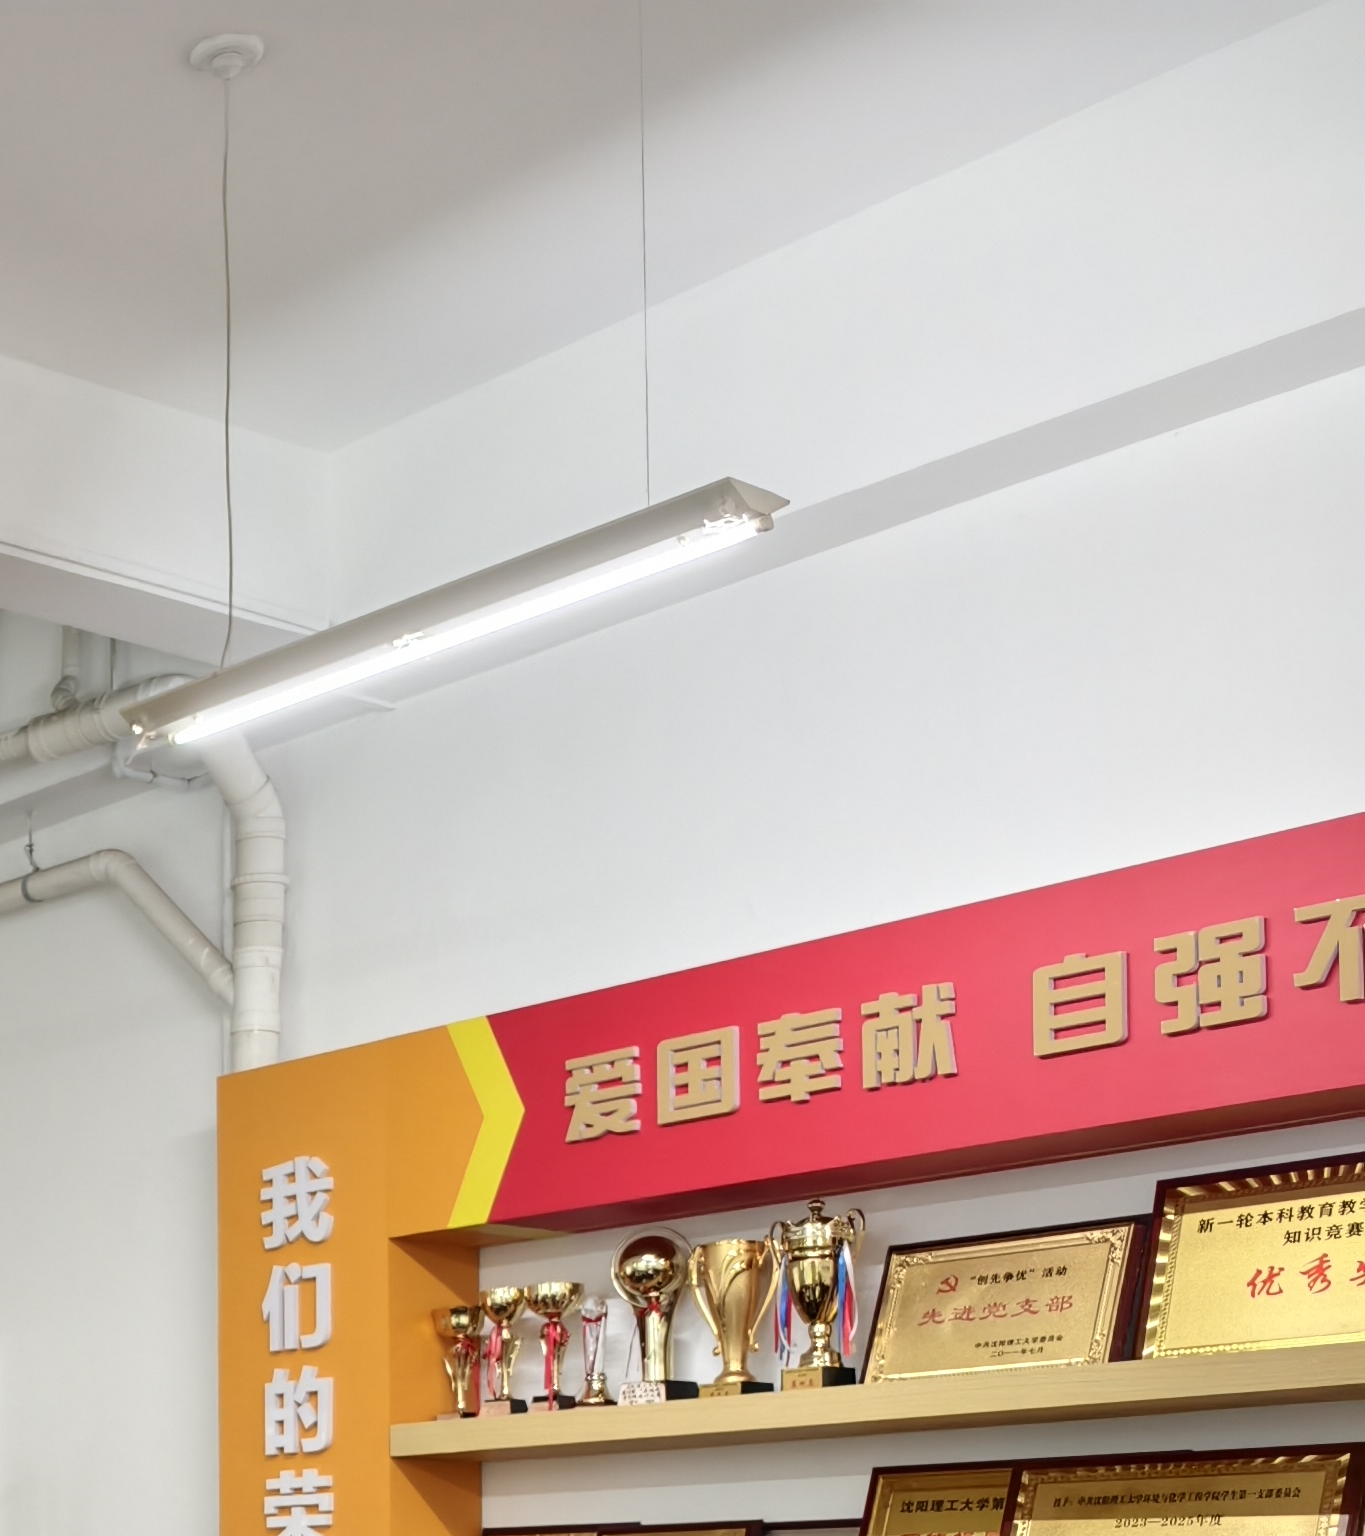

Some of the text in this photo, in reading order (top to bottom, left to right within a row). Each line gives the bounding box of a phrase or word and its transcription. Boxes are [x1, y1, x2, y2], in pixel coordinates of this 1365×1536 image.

[564, 981, 957, 1144] 爱国奉献
[1283, 1221, 1365, 1246] 知识竞赛
[917, 1294, 1074, 1327] 先进党支部
